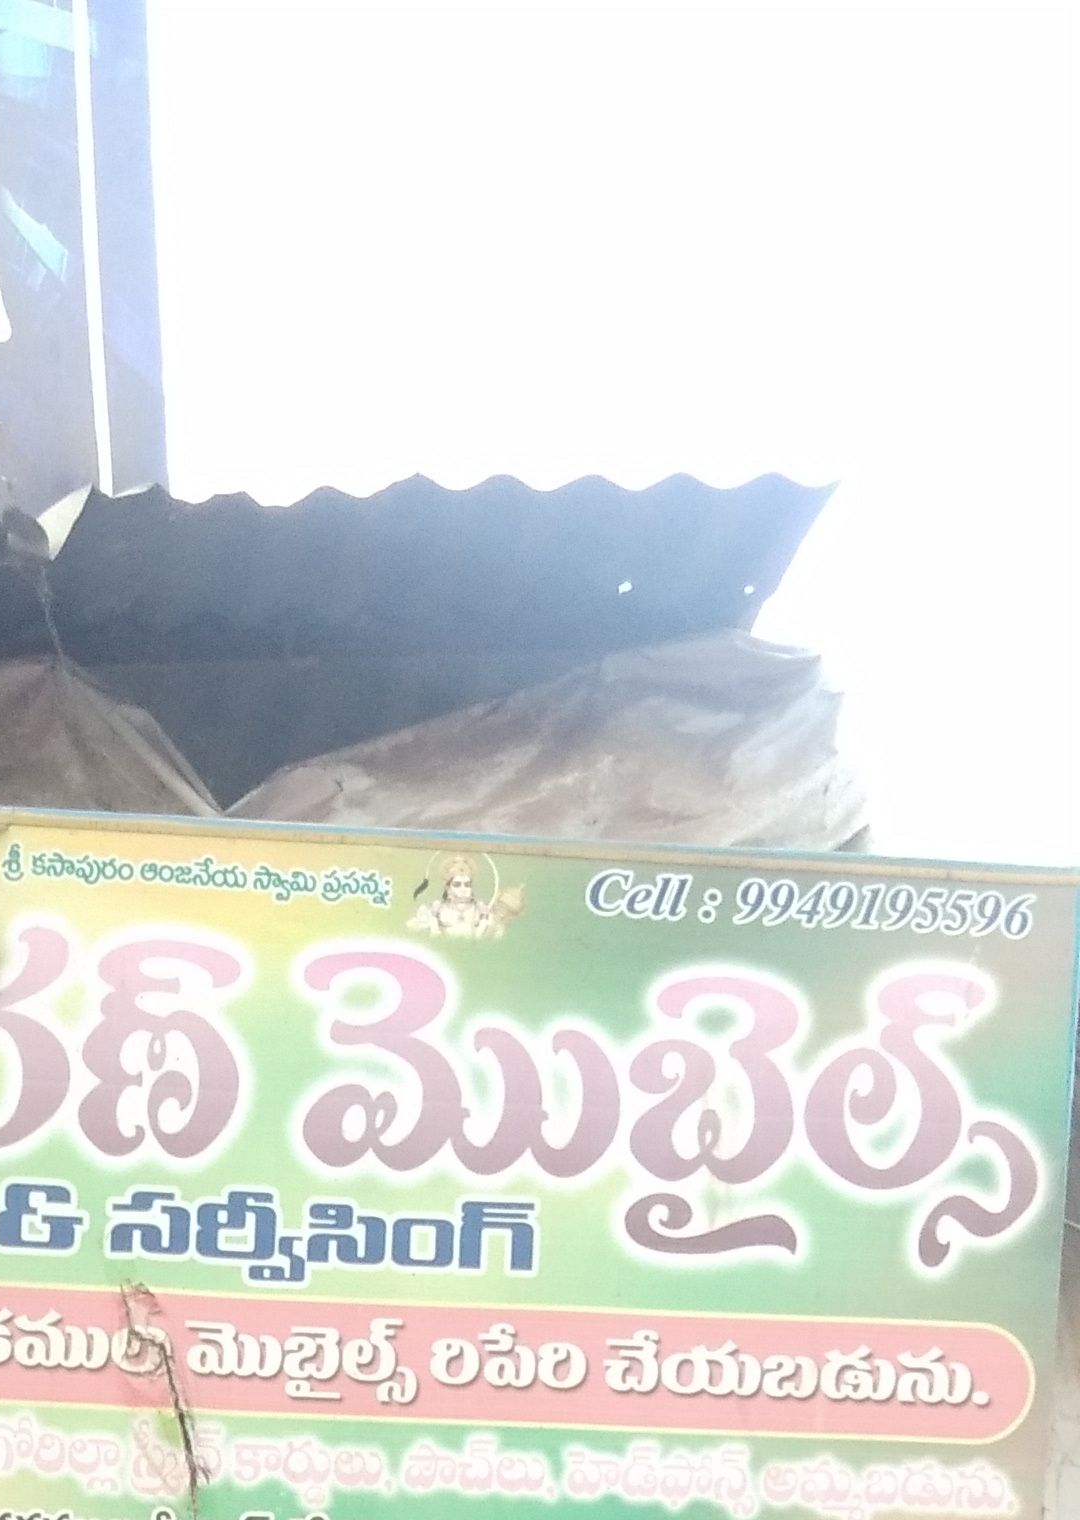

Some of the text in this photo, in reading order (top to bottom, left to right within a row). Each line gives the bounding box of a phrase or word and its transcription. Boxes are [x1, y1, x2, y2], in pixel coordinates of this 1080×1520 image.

[2, 843, 24, 881] శ్రీ
[32, 852, 135, 884] కసాపురం
[140, 858, 248, 889] ఆంజనేయ
[253, 866, 317, 901] స్వామి
[589, 871, 687, 920] Cell
[734, 880, 1035, 938] 9949195596
[303, 950, 1040, 1268] మొబైల్స్
[110, 1190, 536, 1284] సర్వీసింగ్
[185, 1318, 418, 1402] మొబైల్స్
[431, 1326, 588, 1391] రిపేరి
[604, 1336, 991, 1406] చేయబడును.
